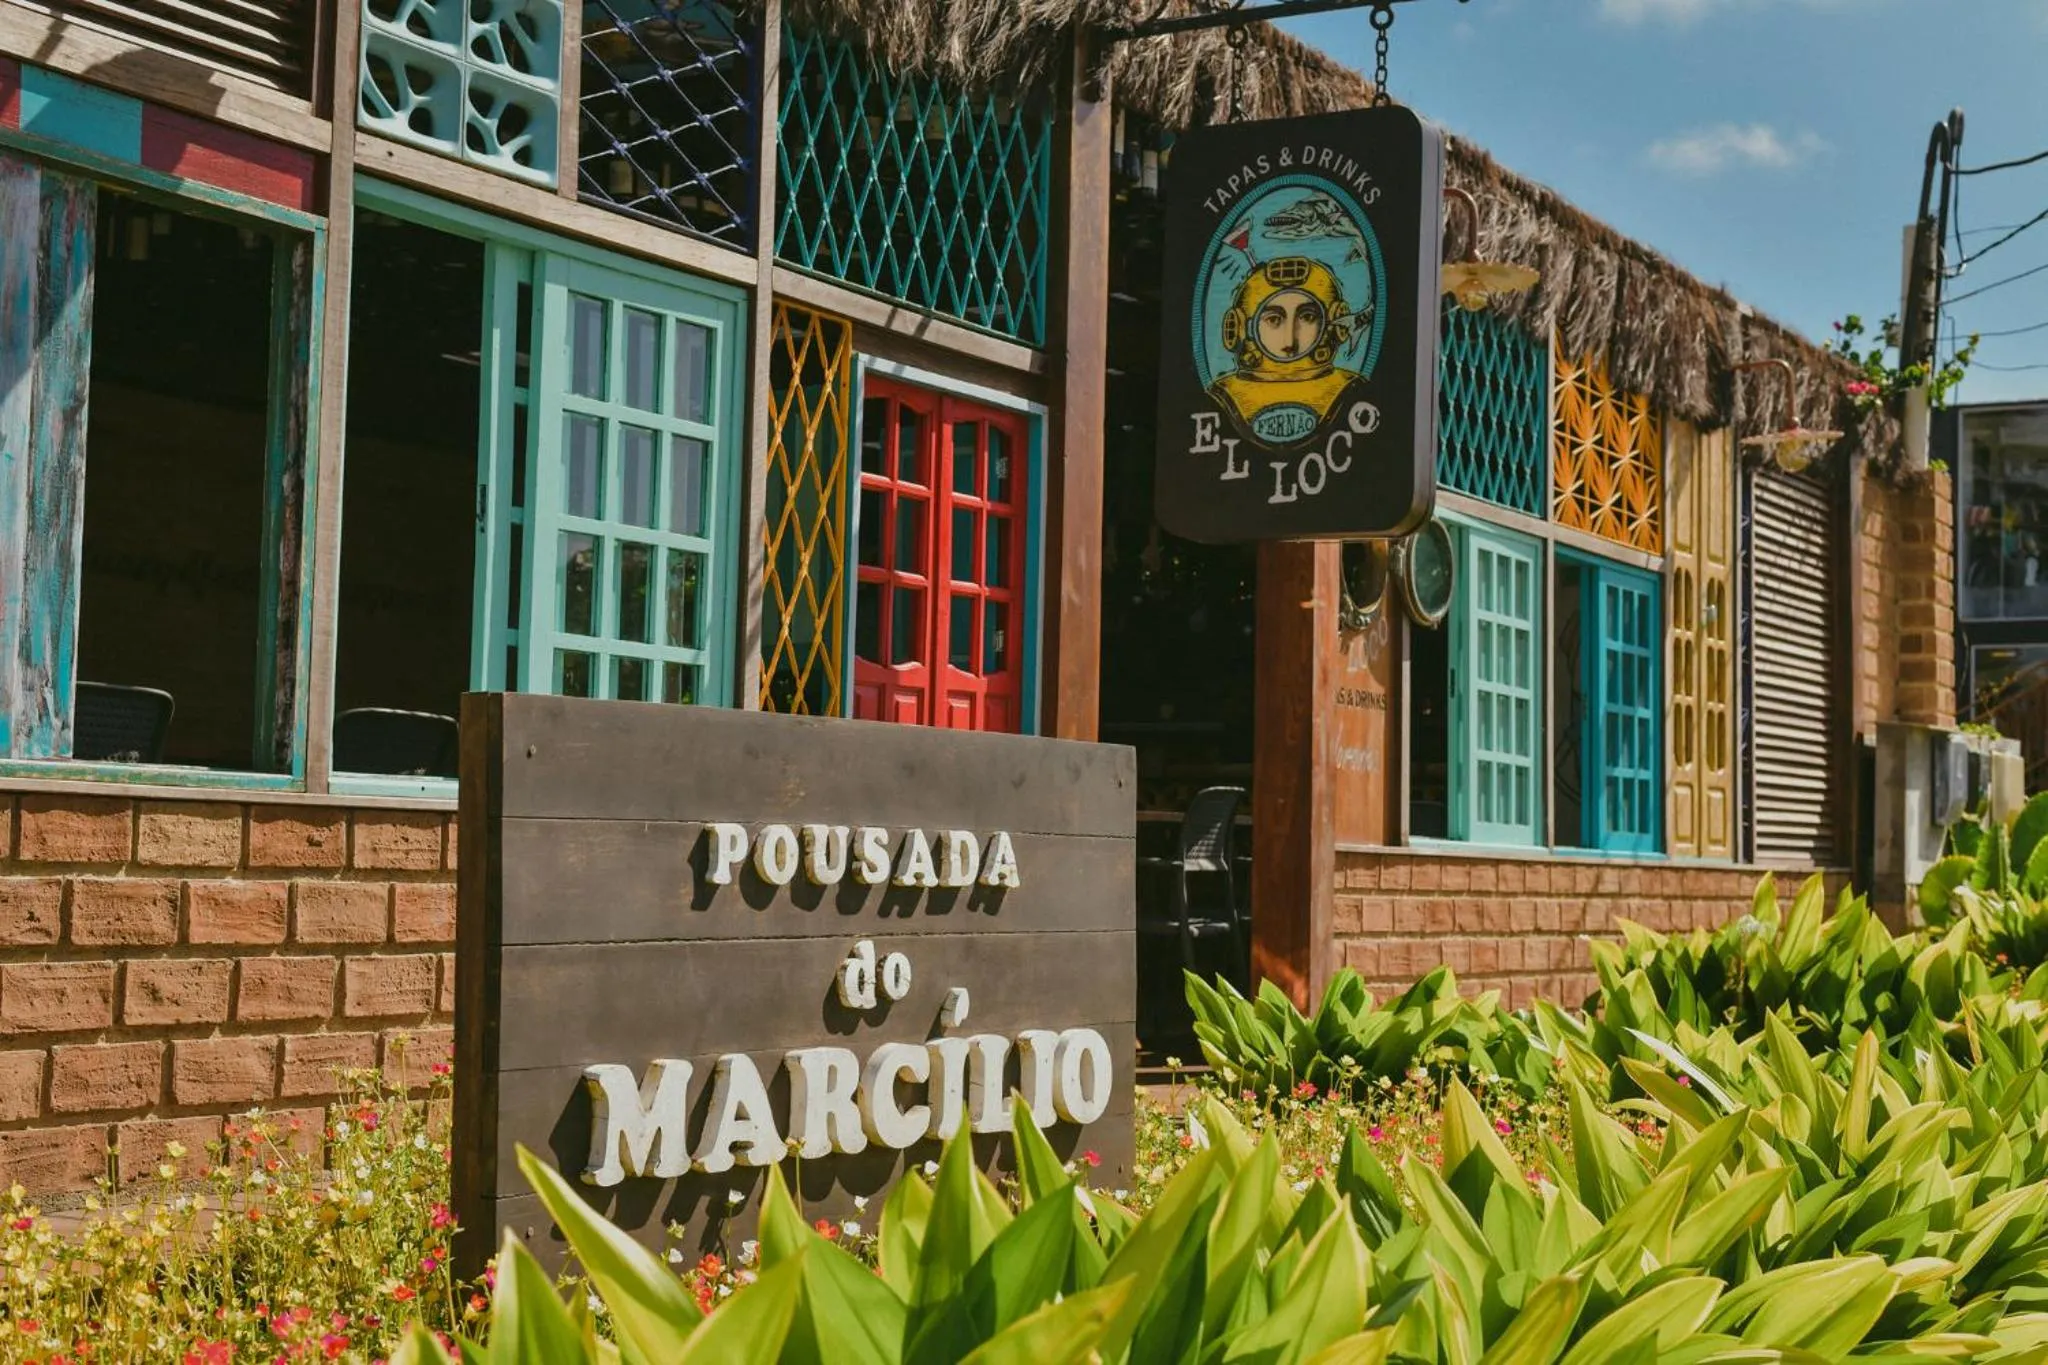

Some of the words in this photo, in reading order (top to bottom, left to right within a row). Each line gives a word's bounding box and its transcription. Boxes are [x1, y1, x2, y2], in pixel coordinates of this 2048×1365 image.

[1203, 155, 1271, 213] TAPAS
[1279, 147, 1293, 167] &
[1302, 145, 1381, 205] DRINKS
[1189, 411, 1249, 480] EL
[1268, 401, 1380, 504] LOCO
[1355, 689, 1388, 710] DRINKS
[705, 822, 1021, 888] POUSADA
[838, 939, 912, 1010] do
[580, 987, 1112, 1187] MARCÍLIO
